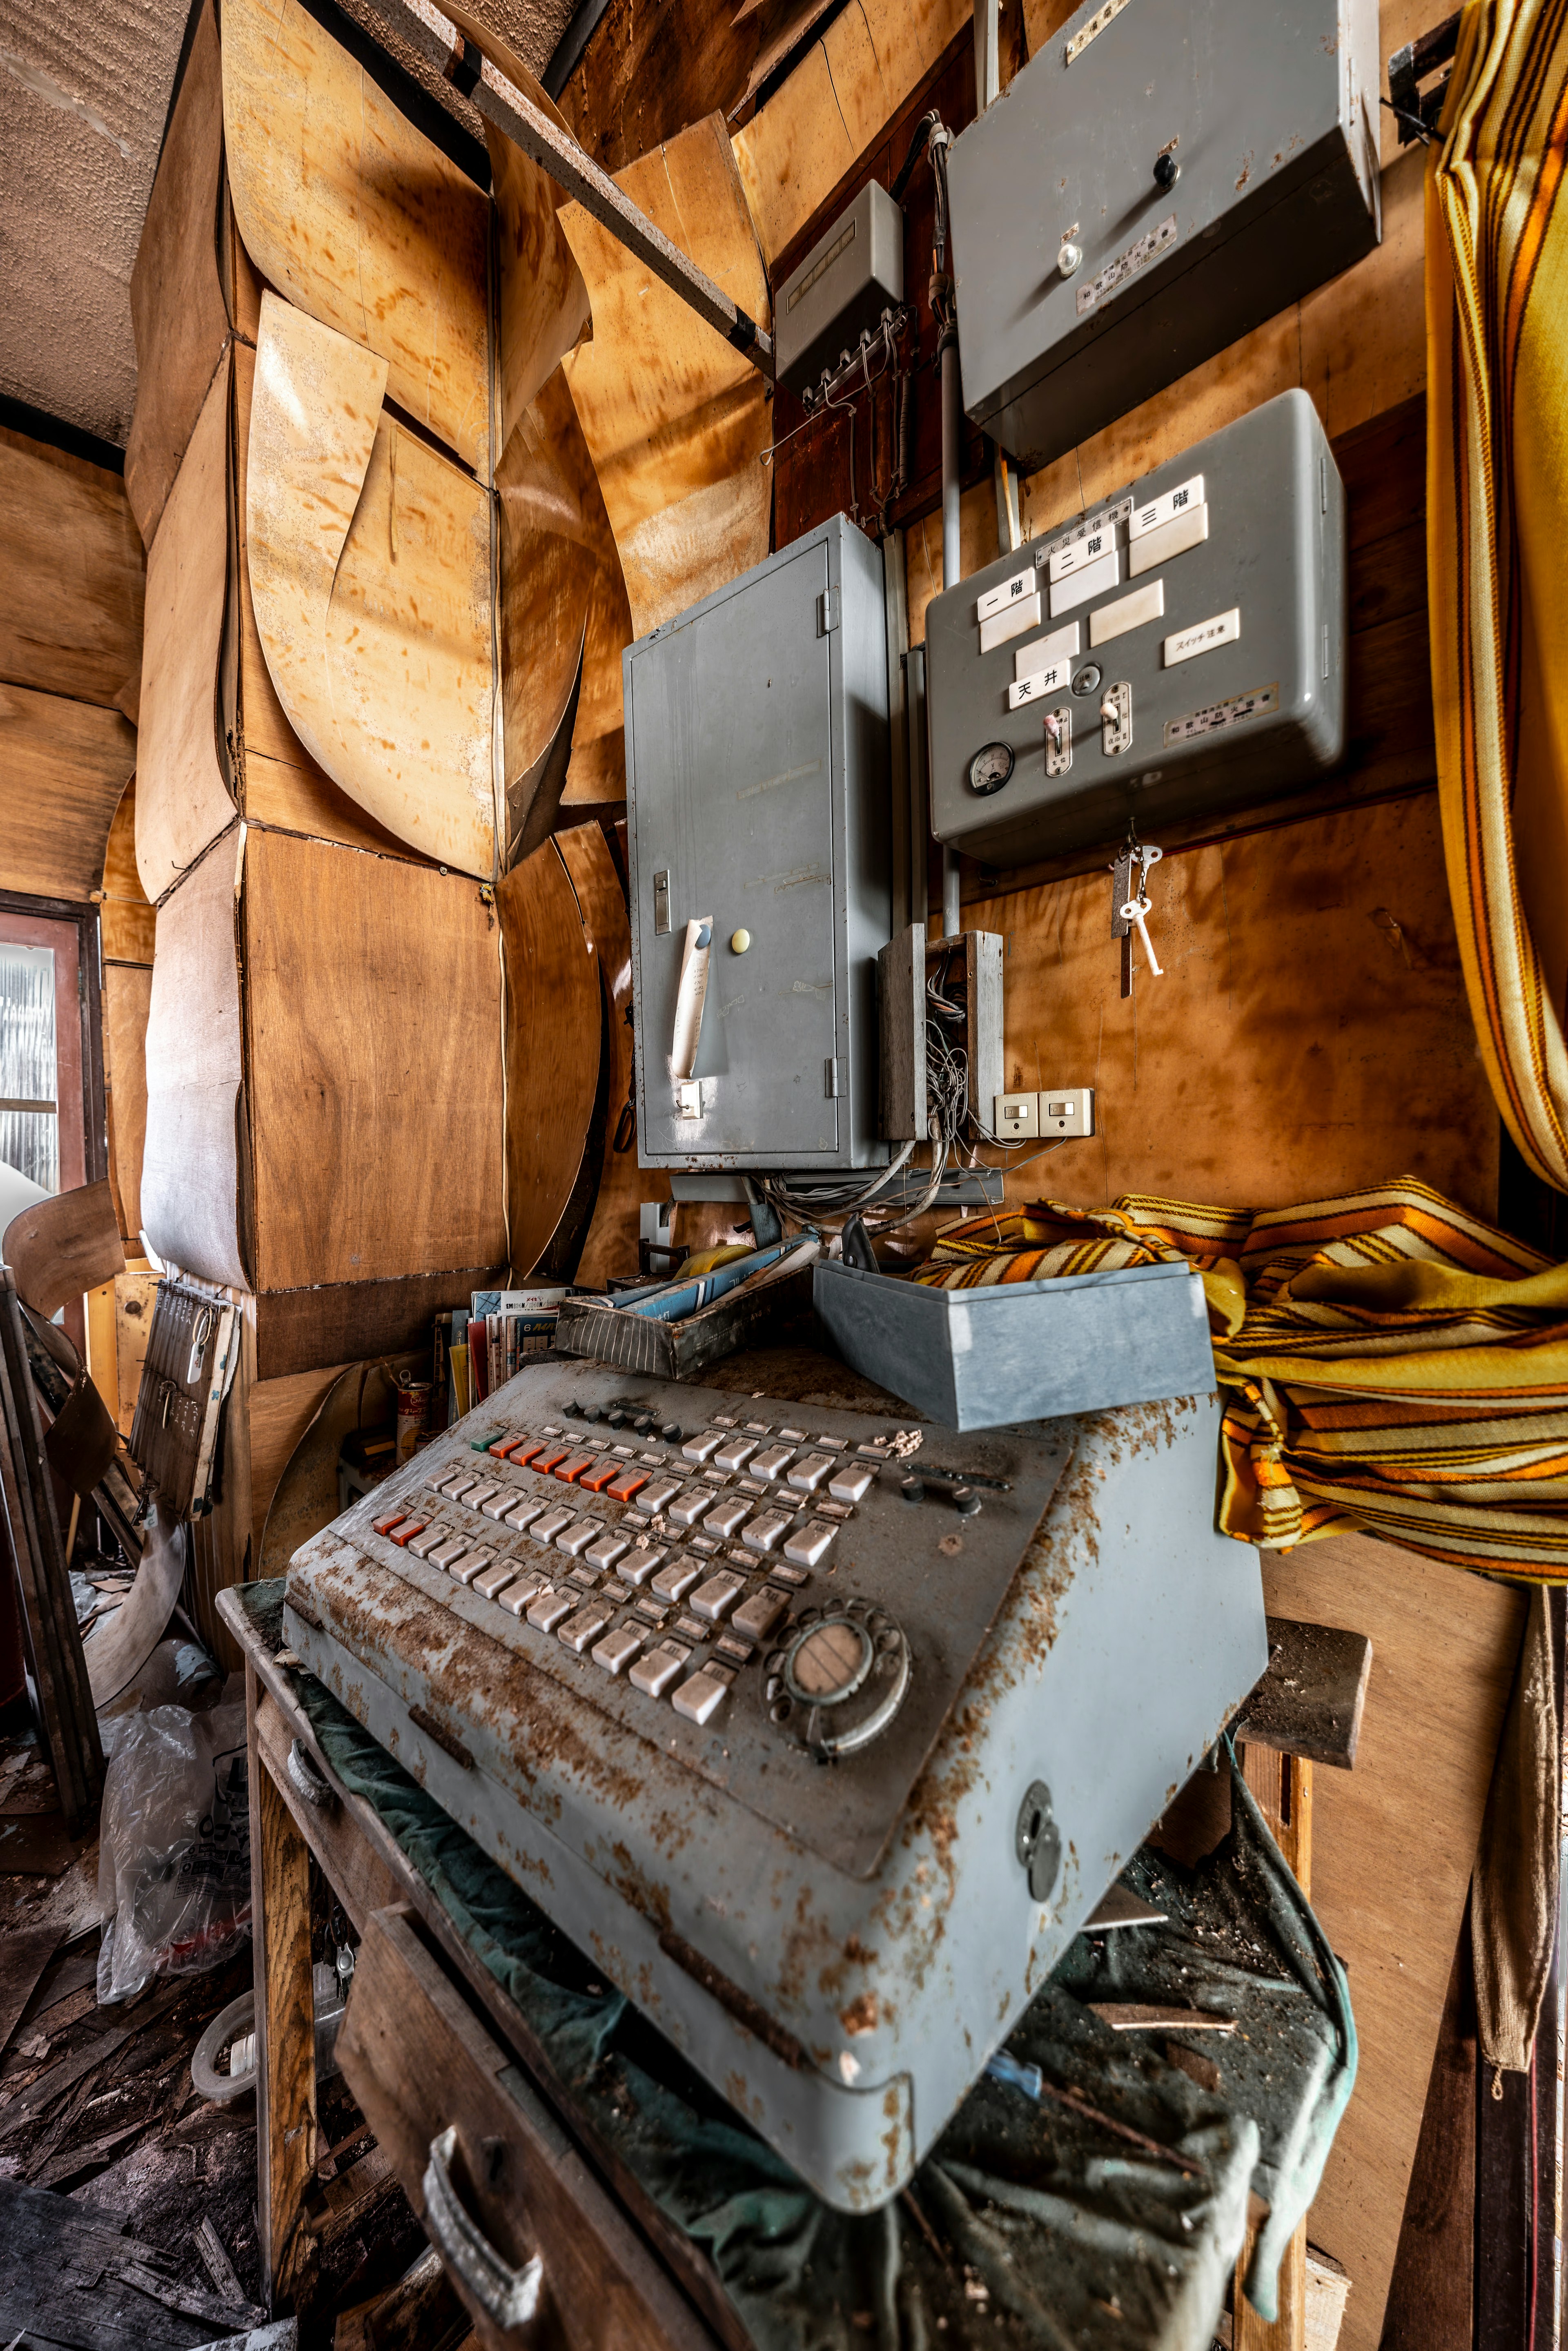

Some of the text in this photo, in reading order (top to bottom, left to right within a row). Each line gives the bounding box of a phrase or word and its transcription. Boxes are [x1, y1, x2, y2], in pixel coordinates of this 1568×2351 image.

[1142, 489, 1189, 527] 三階
[1047, 510, 1118, 557] 火災受信機
[1061, 536, 1102, 570] 二階
[987, 579, 1023, 606] 一階
[1018, 670, 1057, 700] 天井
[1052, 758, 1066, 766] 定位
